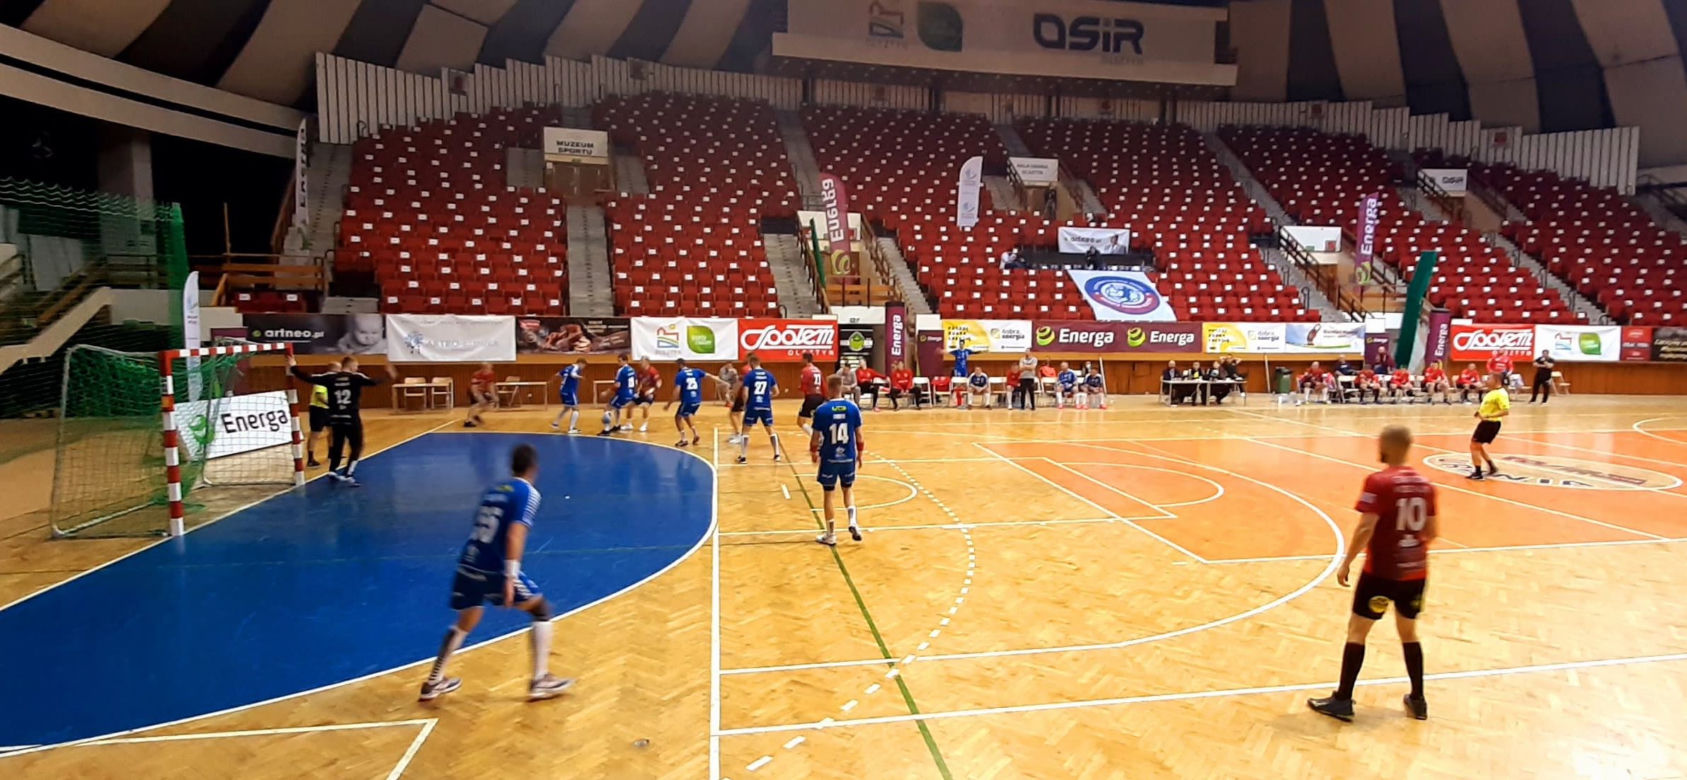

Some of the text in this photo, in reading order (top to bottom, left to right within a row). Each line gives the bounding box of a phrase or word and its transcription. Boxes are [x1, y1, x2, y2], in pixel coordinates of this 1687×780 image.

[556, 140, 594, 148] MUZEUM
[558, 147, 592, 155] SPORTU
[821, 178, 844, 242] Energa
[1361, 198, 1378, 255] Energa
[264, 328, 324, 339] artneo.pl
[891, 314, 905, 356] Energa
[1059, 328, 1114, 347] Energa
[1150, 331, 1195, 346] Energa
[1435, 323, 1448, 356] Energa
[334, 389, 351, 404] 12
[754, 381, 768, 395] 27
[221, 409, 289, 434] Energa
[829, 422, 849, 445] 14
[1395, 496, 1427, 531] 10
